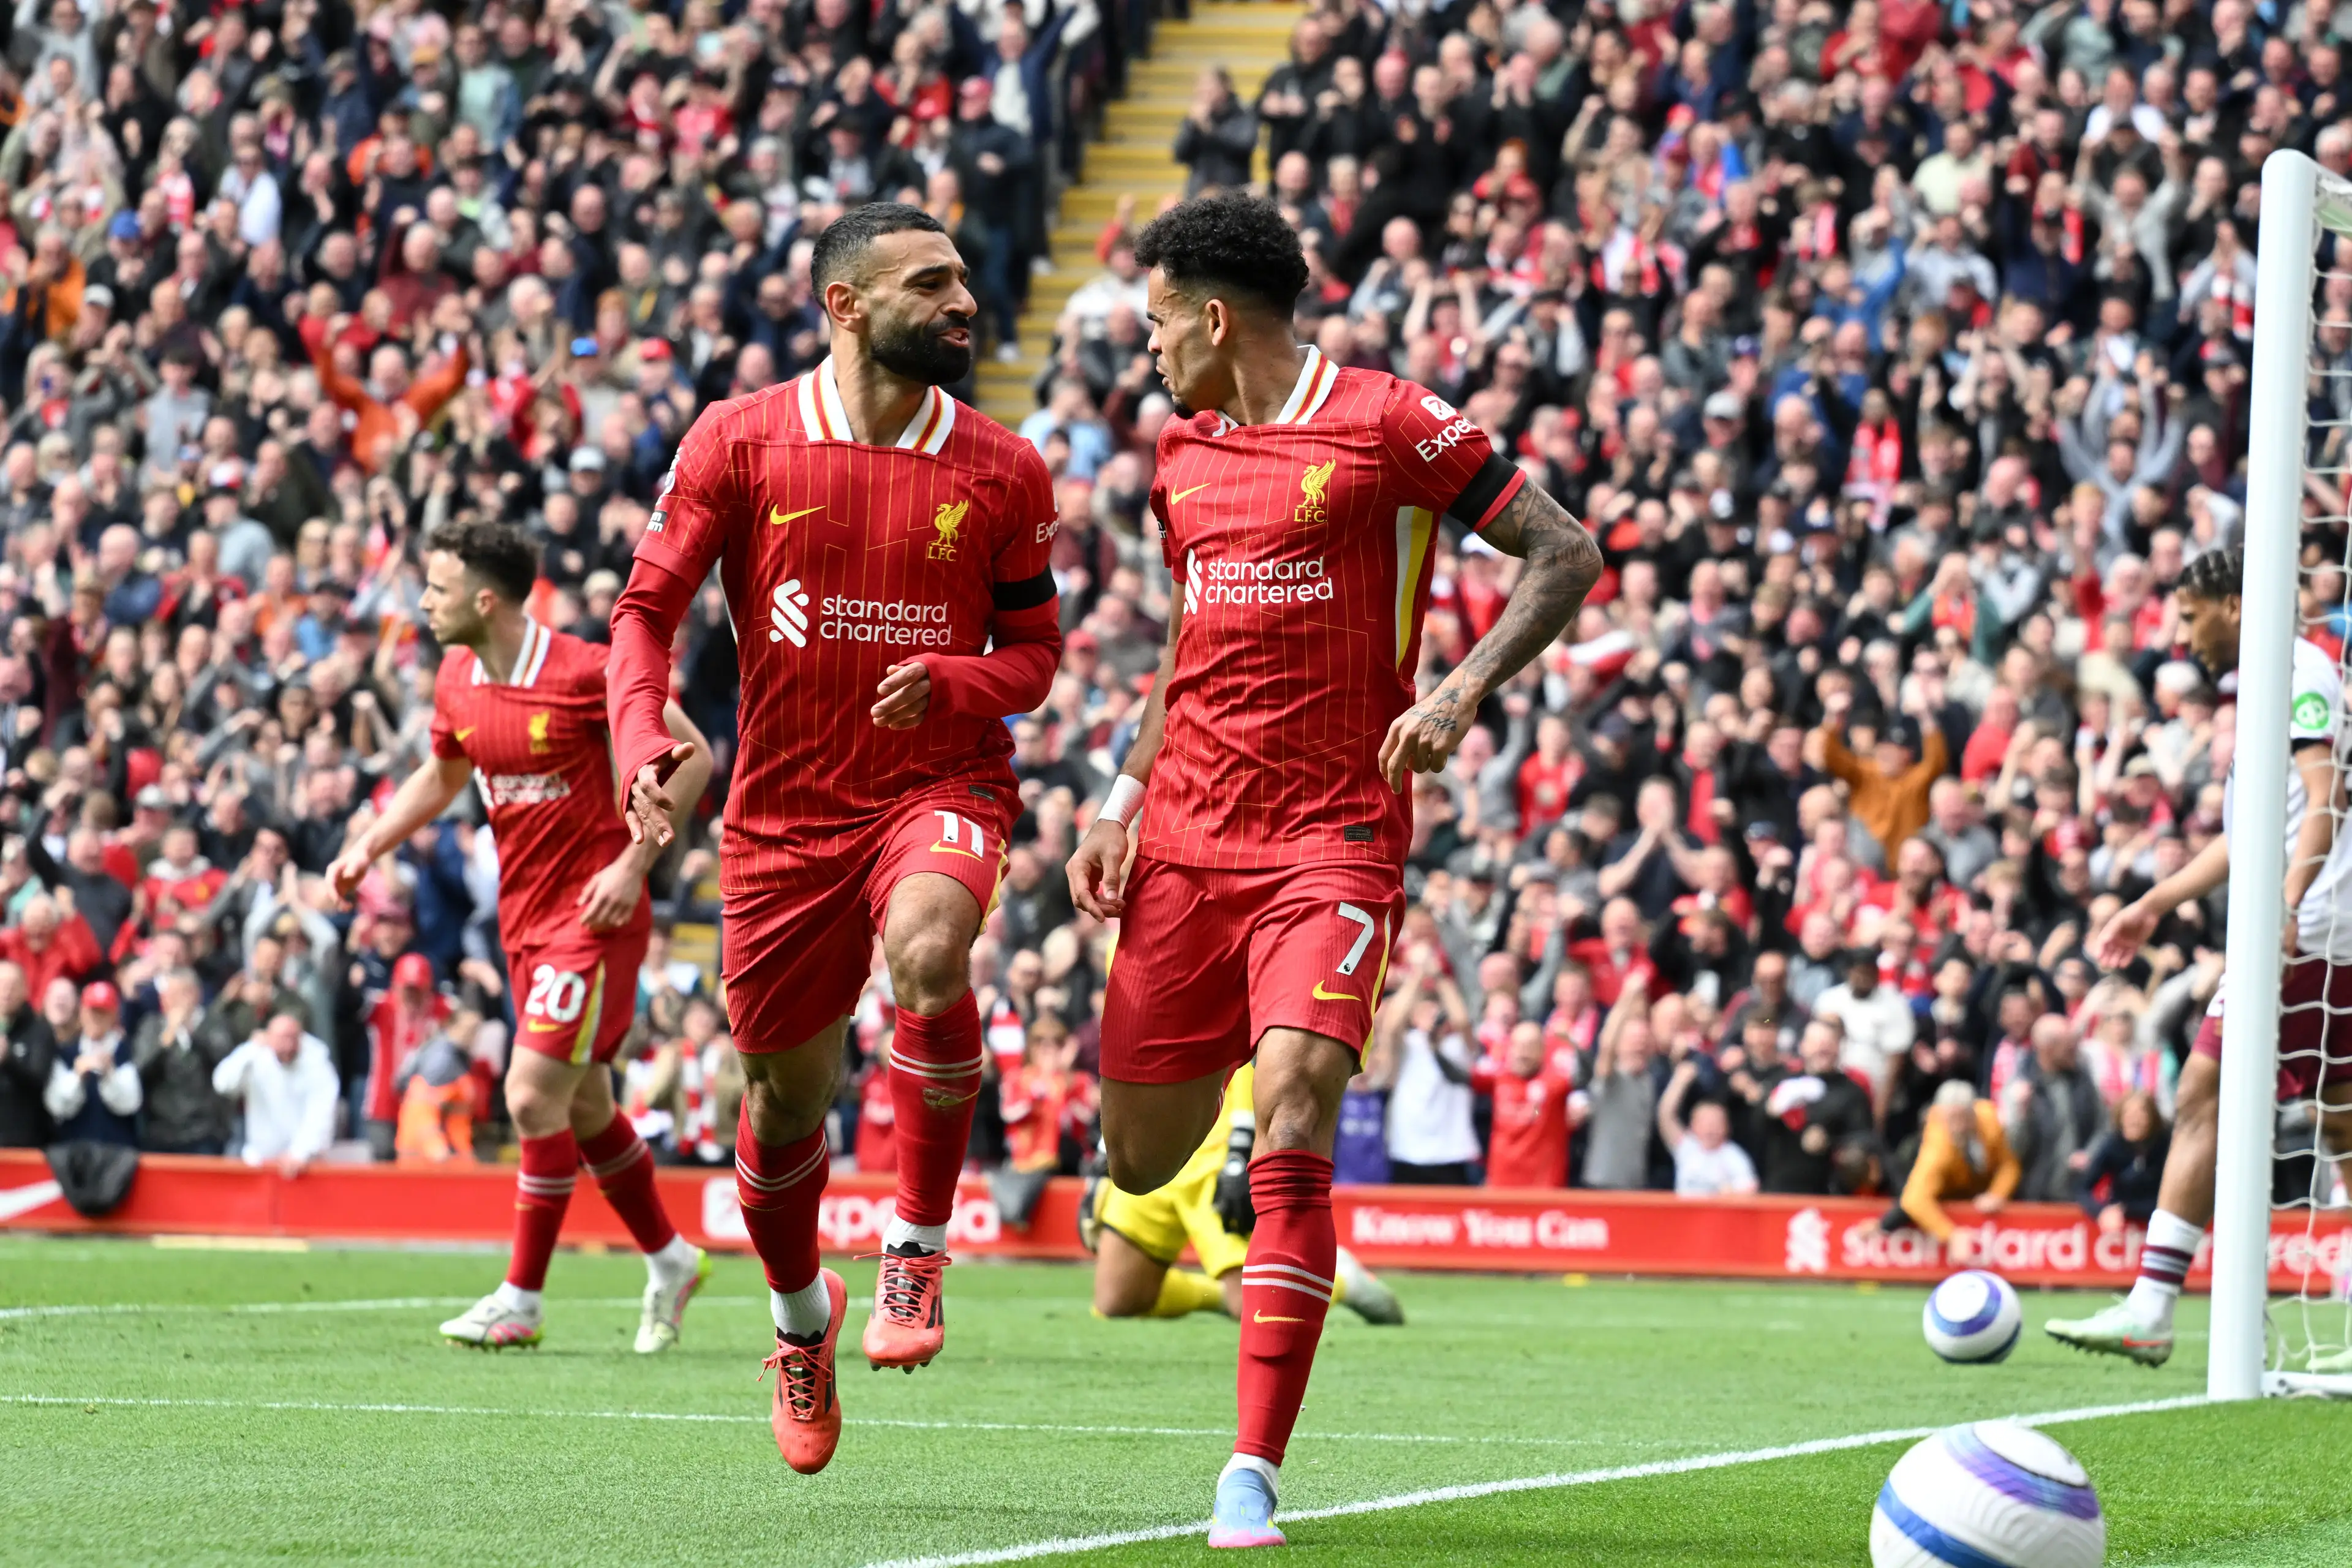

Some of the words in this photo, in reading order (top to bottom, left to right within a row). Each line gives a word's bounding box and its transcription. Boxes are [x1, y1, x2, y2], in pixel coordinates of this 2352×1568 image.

[1208, 556, 1324, 580] standard
[821, 594, 948, 623] standard
[1205, 577, 1333, 604] chartered
[820, 617, 952, 646] chartered
[934, 810, 984, 858] 11
[1335, 902, 1374, 976] 7
[525, 963, 586, 1022] 20
[1351, 1206, 1458, 1245] Know
[1462, 1208, 1532, 1247] You
[1536, 1209, 1609, 1250] Can
